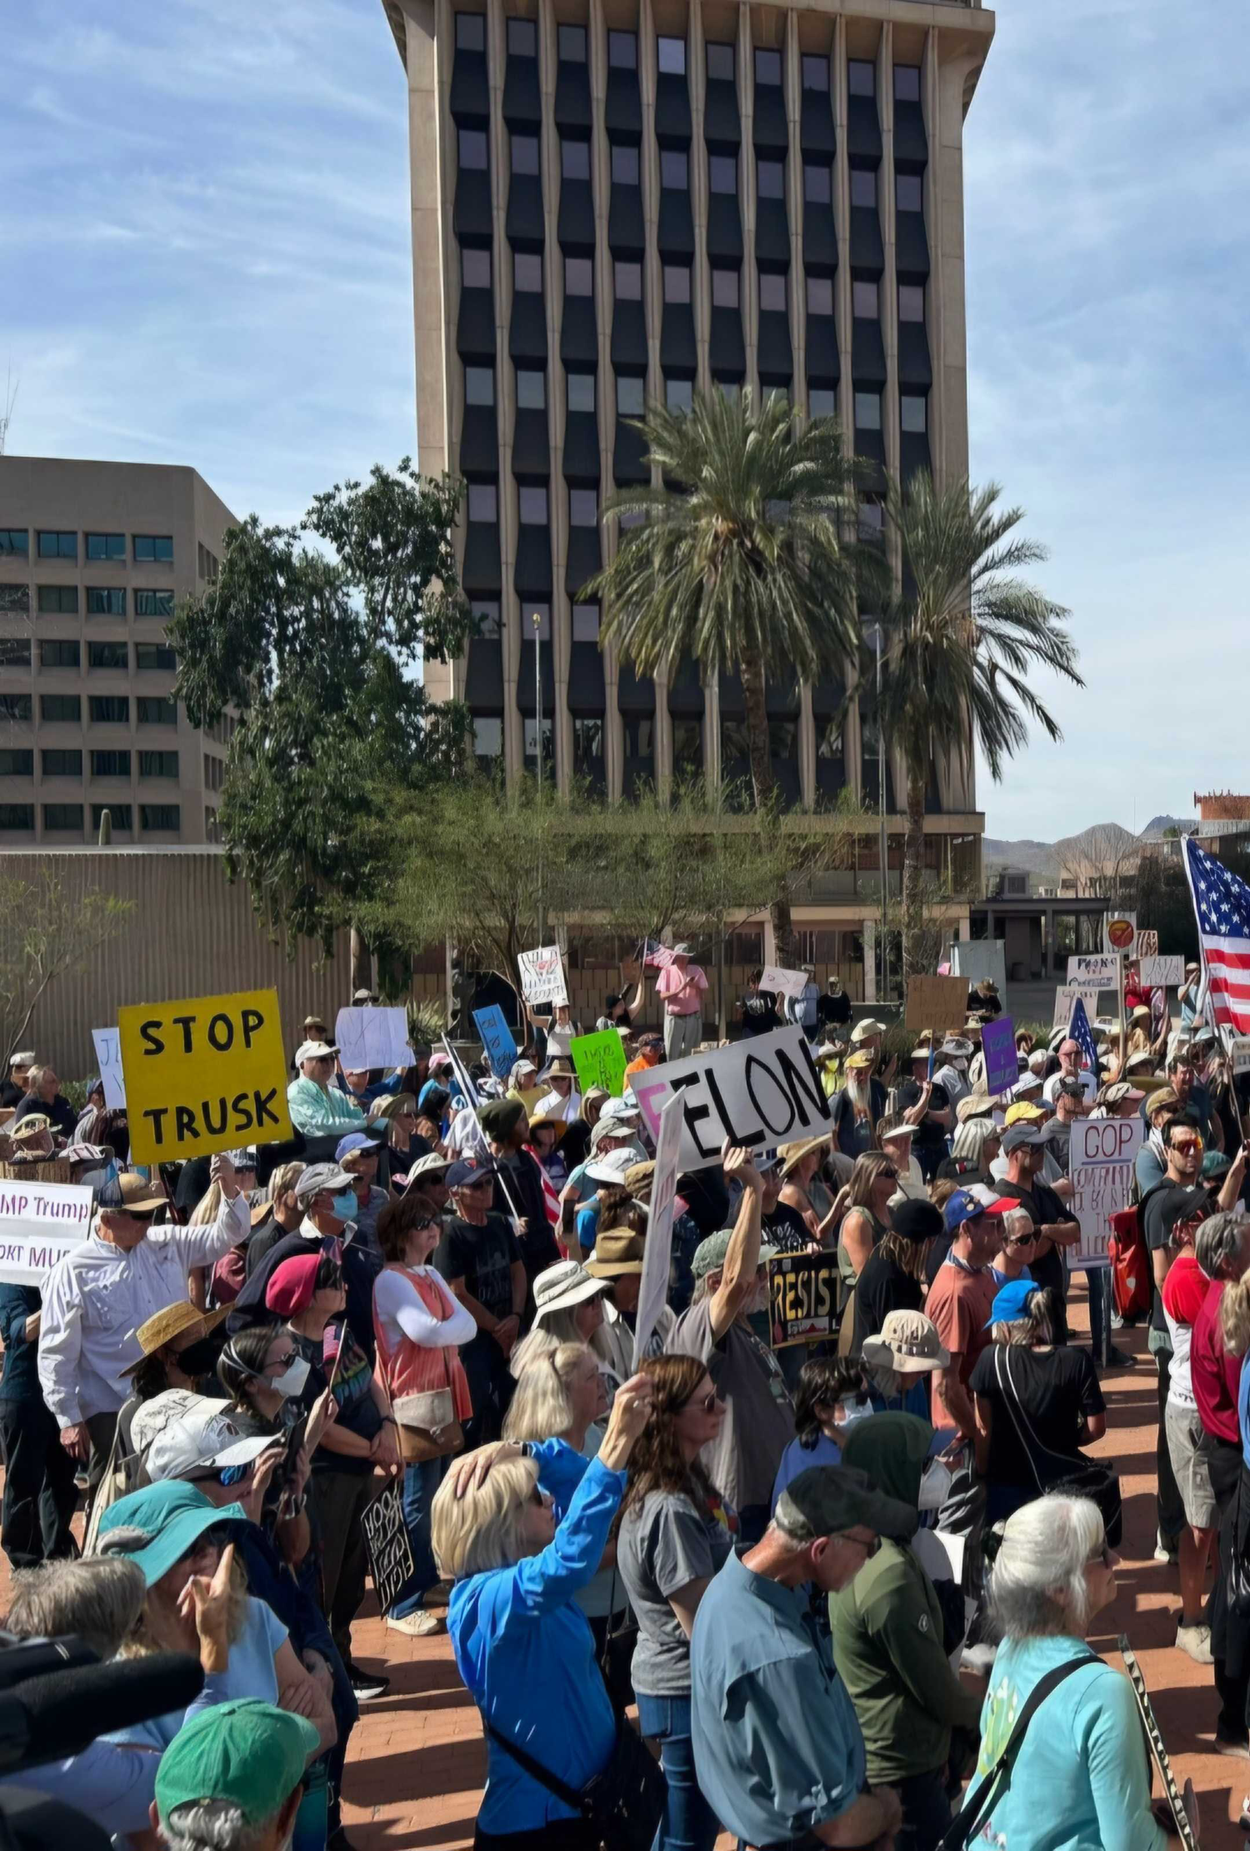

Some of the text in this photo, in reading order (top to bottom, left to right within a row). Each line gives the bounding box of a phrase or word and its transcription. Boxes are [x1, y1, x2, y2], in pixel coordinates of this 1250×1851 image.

[140, 1009, 264, 1056] STOP
[142, 1087, 280, 1145] TRUSK
[33, 1196, 89, 1223] Trump
[28, 1246, 70, 1269] MU
[774, 1268, 842, 1323] RESIST
